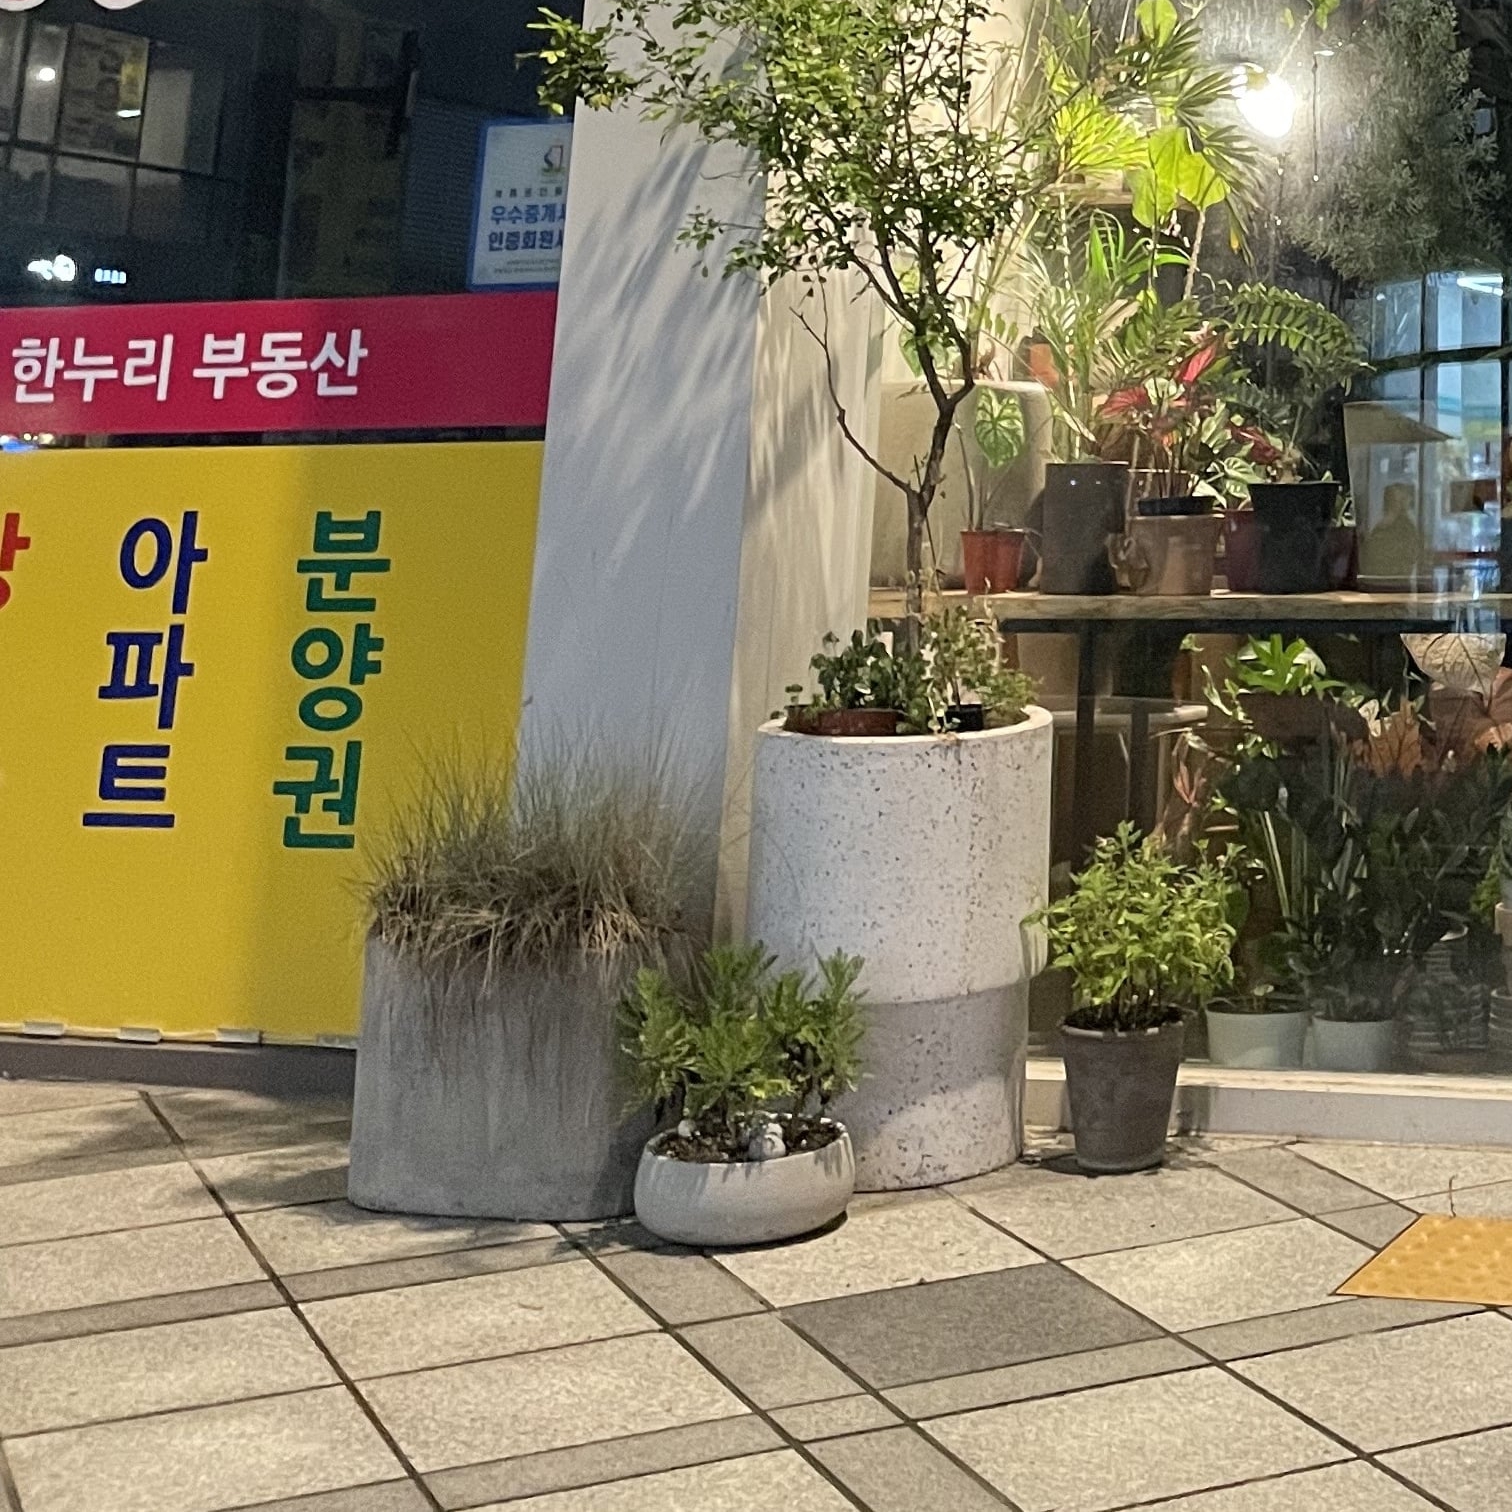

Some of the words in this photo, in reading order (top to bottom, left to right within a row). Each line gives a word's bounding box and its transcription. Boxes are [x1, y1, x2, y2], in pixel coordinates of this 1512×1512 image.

[12, 334, 174, 403] 한누리
[193, 329, 368, 399] 부동산
[82, 510, 208, 828] 아파트
[272, 510, 391, 849] 분양권
